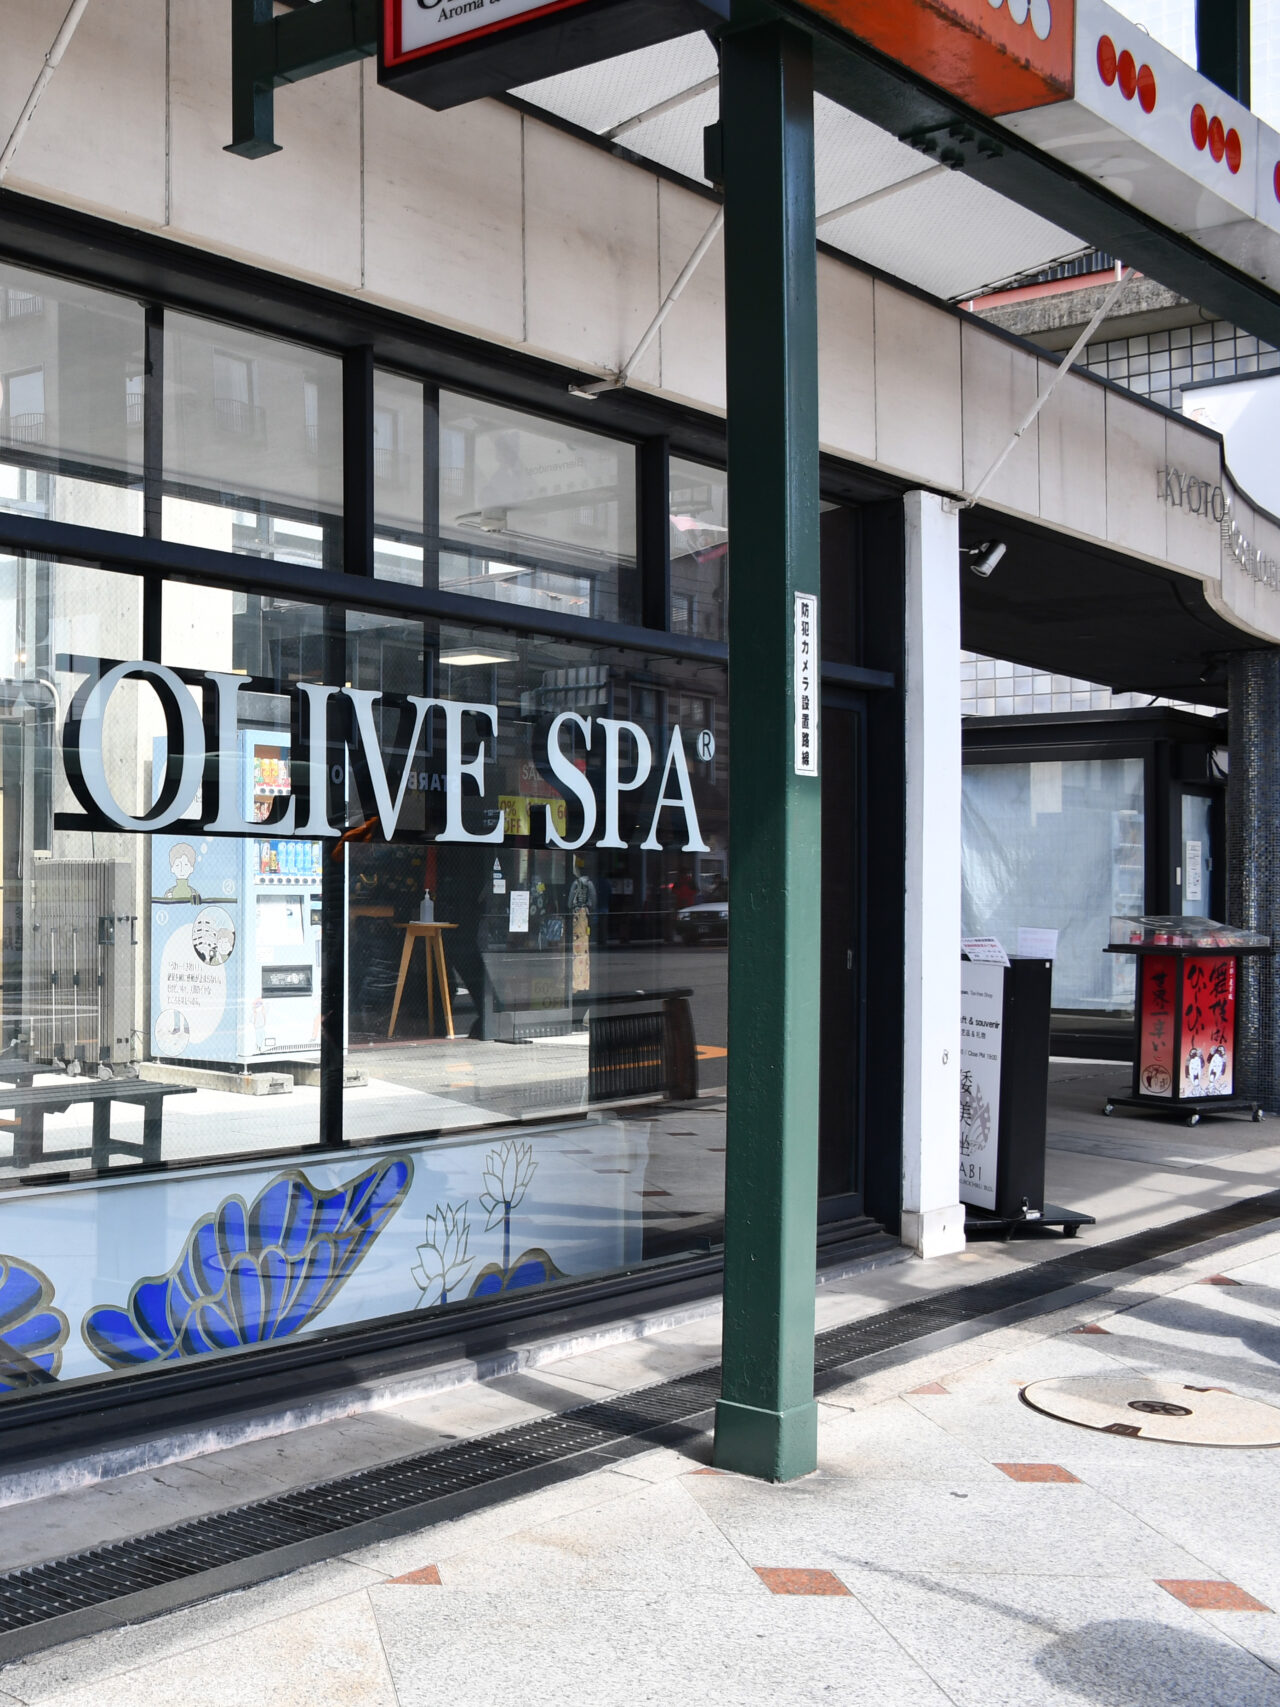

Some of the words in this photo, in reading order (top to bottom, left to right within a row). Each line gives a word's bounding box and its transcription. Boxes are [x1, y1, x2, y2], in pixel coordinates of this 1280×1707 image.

[437, 0, 484, 23] Aroma
[1164, 464, 1225, 523] KYOTO
[78, 660, 504, 844] OLIVE
[975, 1019, 1000, 1029] souvenir
[959, 1161, 982, 1181] ABI
